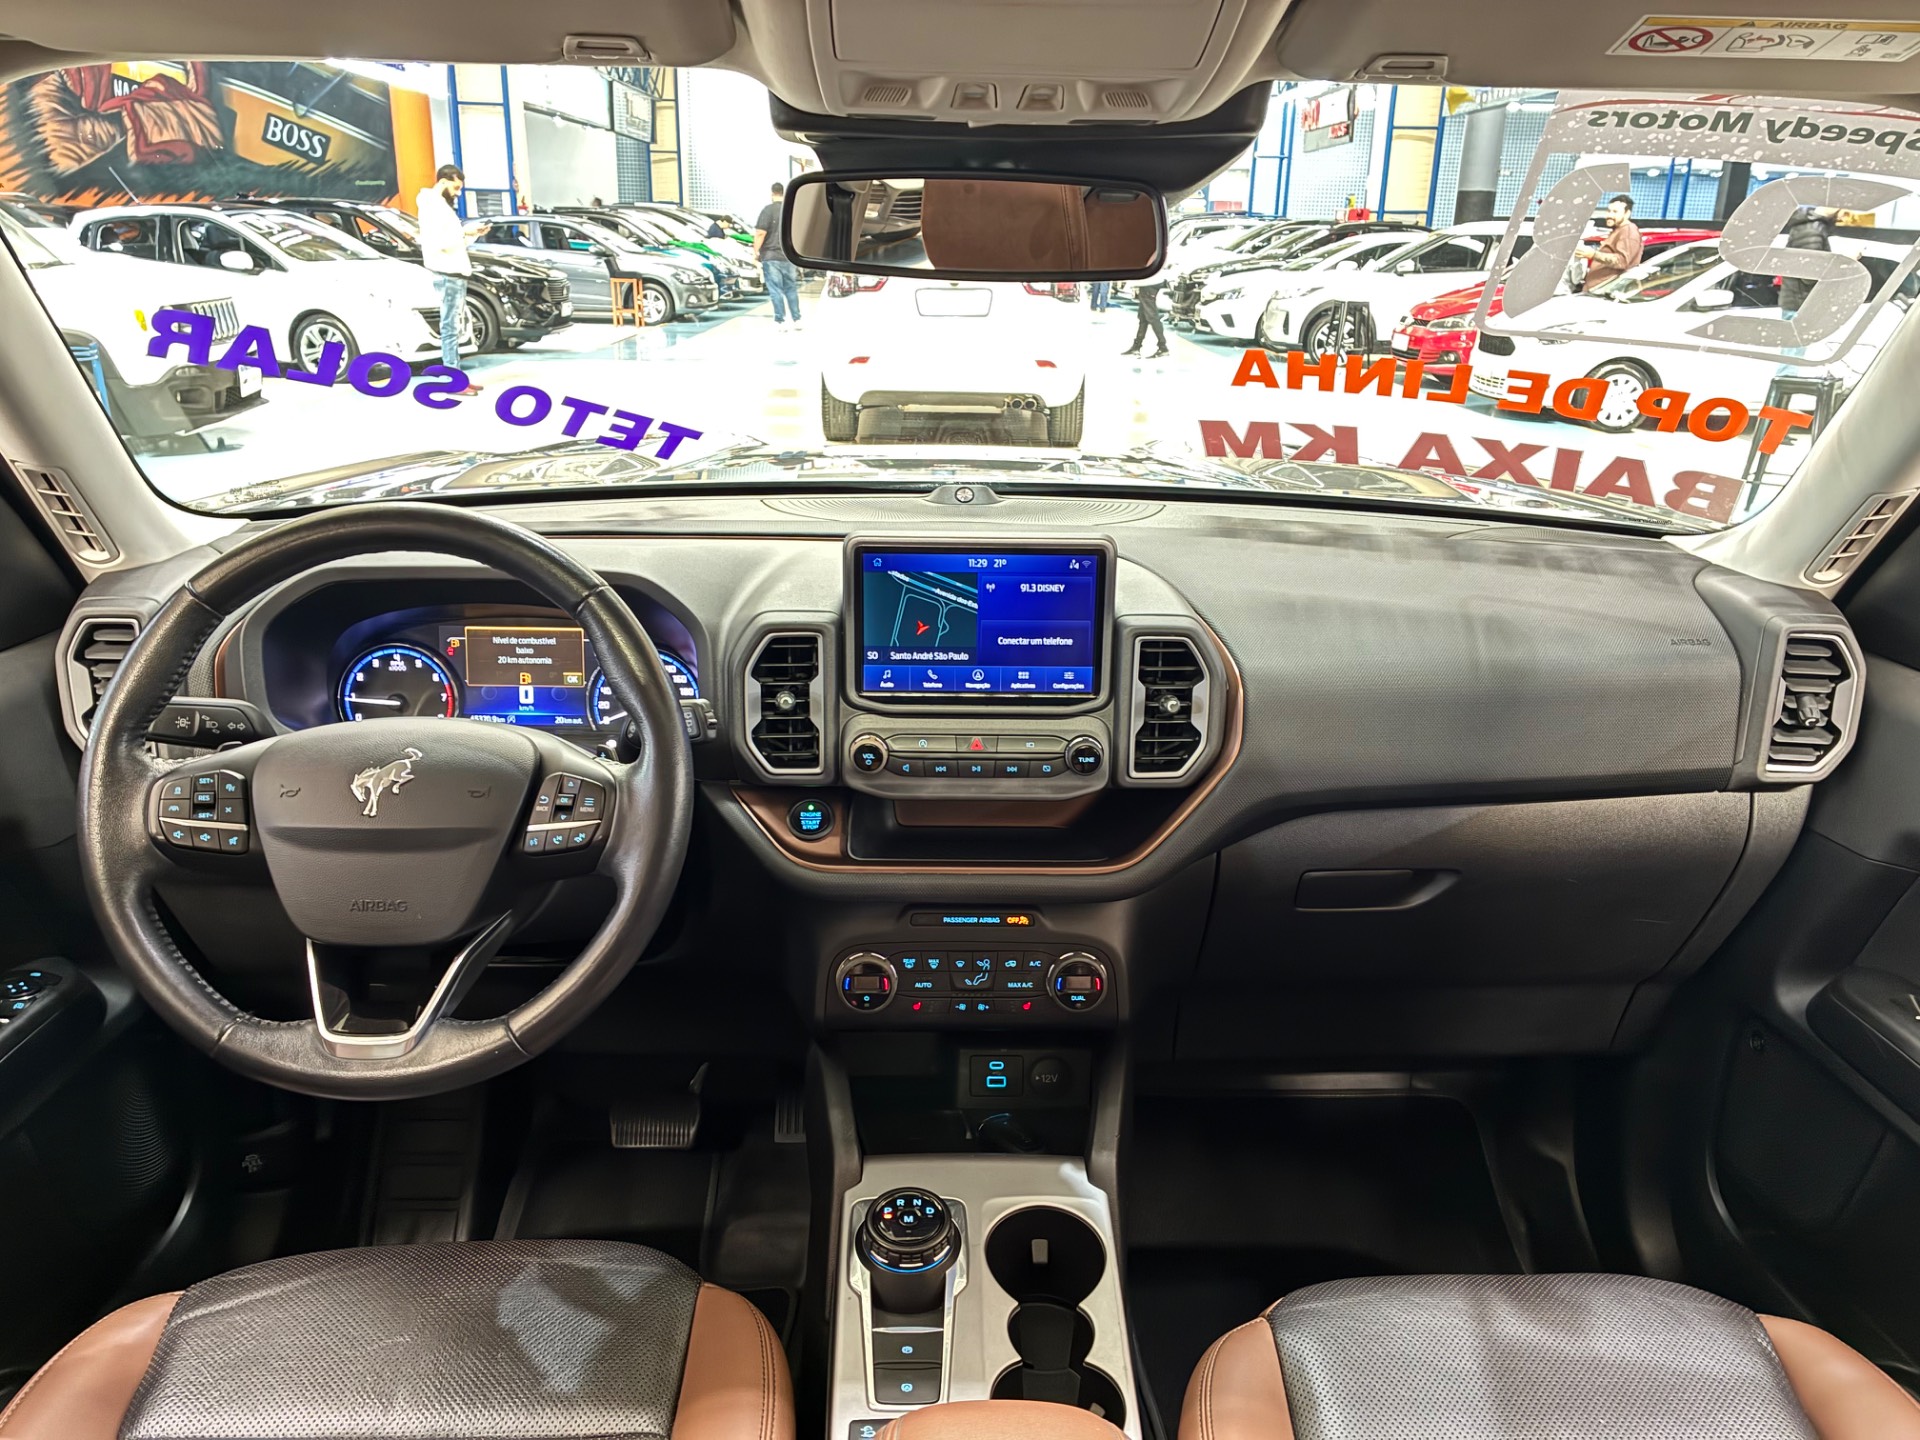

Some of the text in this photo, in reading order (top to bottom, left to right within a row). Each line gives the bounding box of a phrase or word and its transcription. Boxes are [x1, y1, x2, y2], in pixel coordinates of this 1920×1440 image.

[1770, 21, 1848, 31] AIRBAG
[266, 116, 326, 158] BOSS
[968, 558, 988, 568] 11:29
[1020, 583, 1065, 593] 91.3 DISNEY
[997, 636, 1073, 646] Conectar um telefone
[1670, 638, 1713, 647] AIRBAG
[518, 656, 553, 665] autonomia
[890, 651, 970, 661] Santo André São Paulo
[567, 676, 579, 684] OK
[440, 693, 448, 702] 7
[519, 685, 534, 704] 0
[197, 794, 210, 802] RES
[560, 796, 570, 804] OK
[350, 899, 408, 913] AIRBAG
[943, 916, 1019, 924] PASSENGER AIRBAG OFF
[903, 1215, 914, 1223] M
